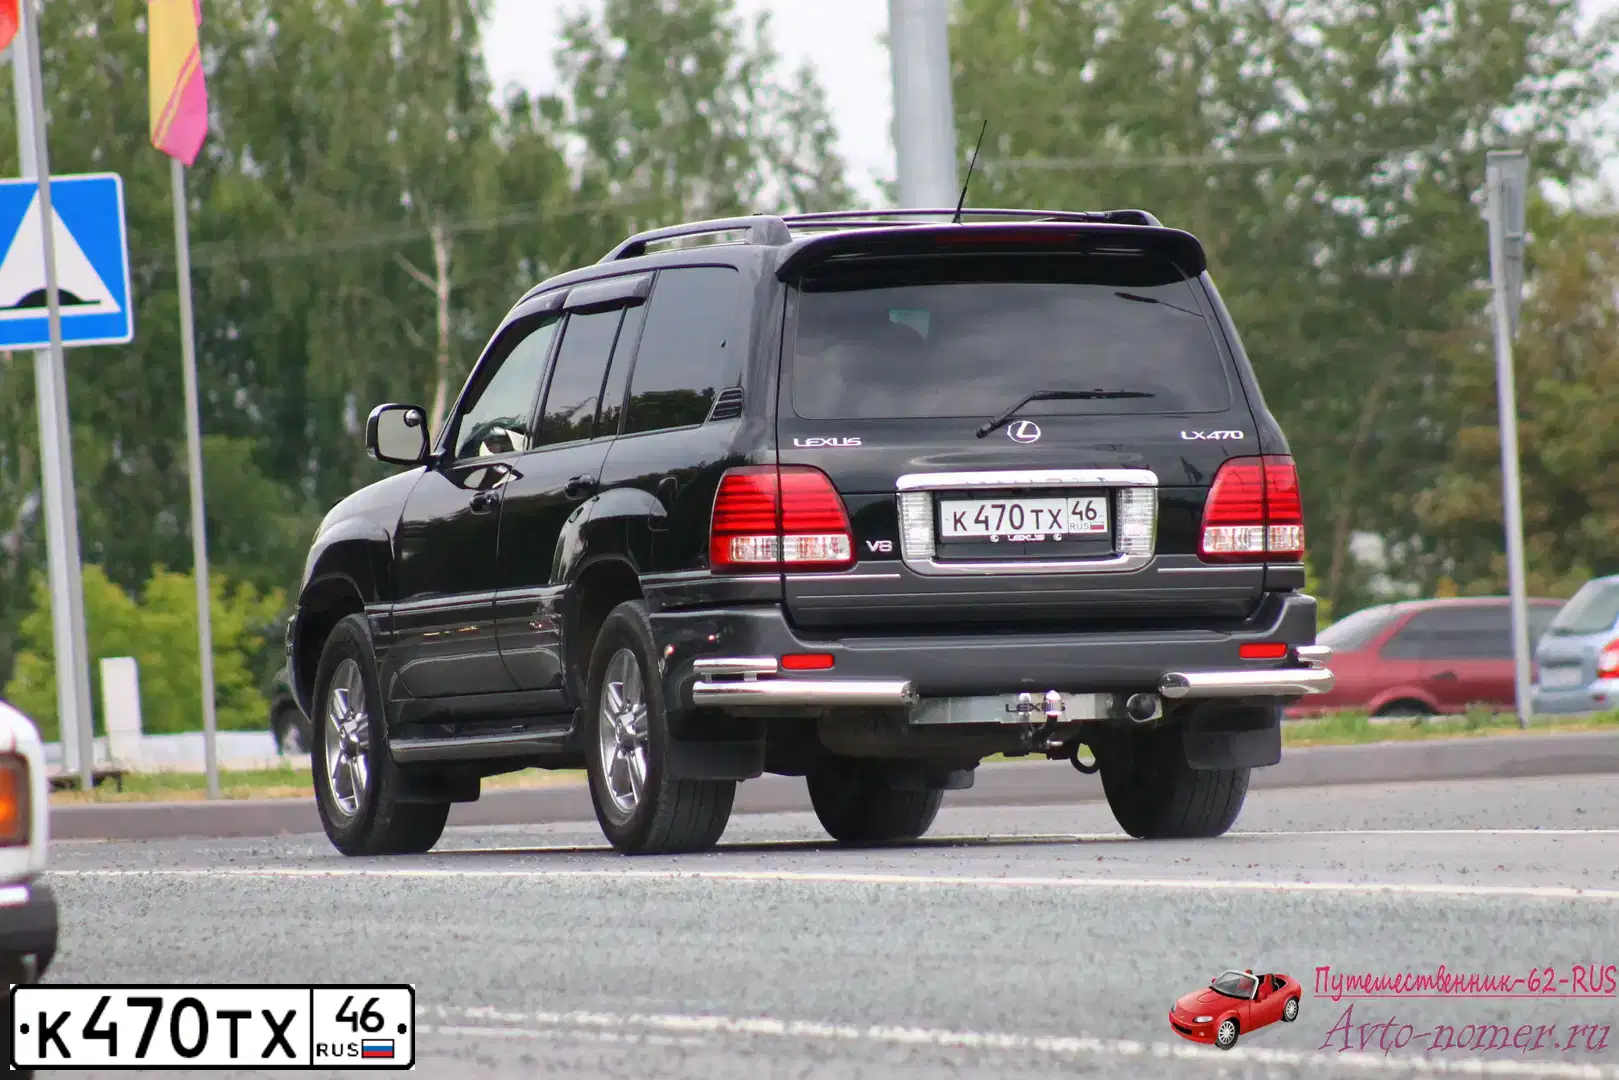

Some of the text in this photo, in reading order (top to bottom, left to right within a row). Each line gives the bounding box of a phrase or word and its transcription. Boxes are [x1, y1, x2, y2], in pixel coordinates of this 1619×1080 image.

[793, 437, 862, 447] LEXUS
[1071, 500, 1097, 521] 46
[1069, 523, 1089, 531] RUS
[865, 540, 893, 552] V8
[1005, 702, 1066, 714] LEX
